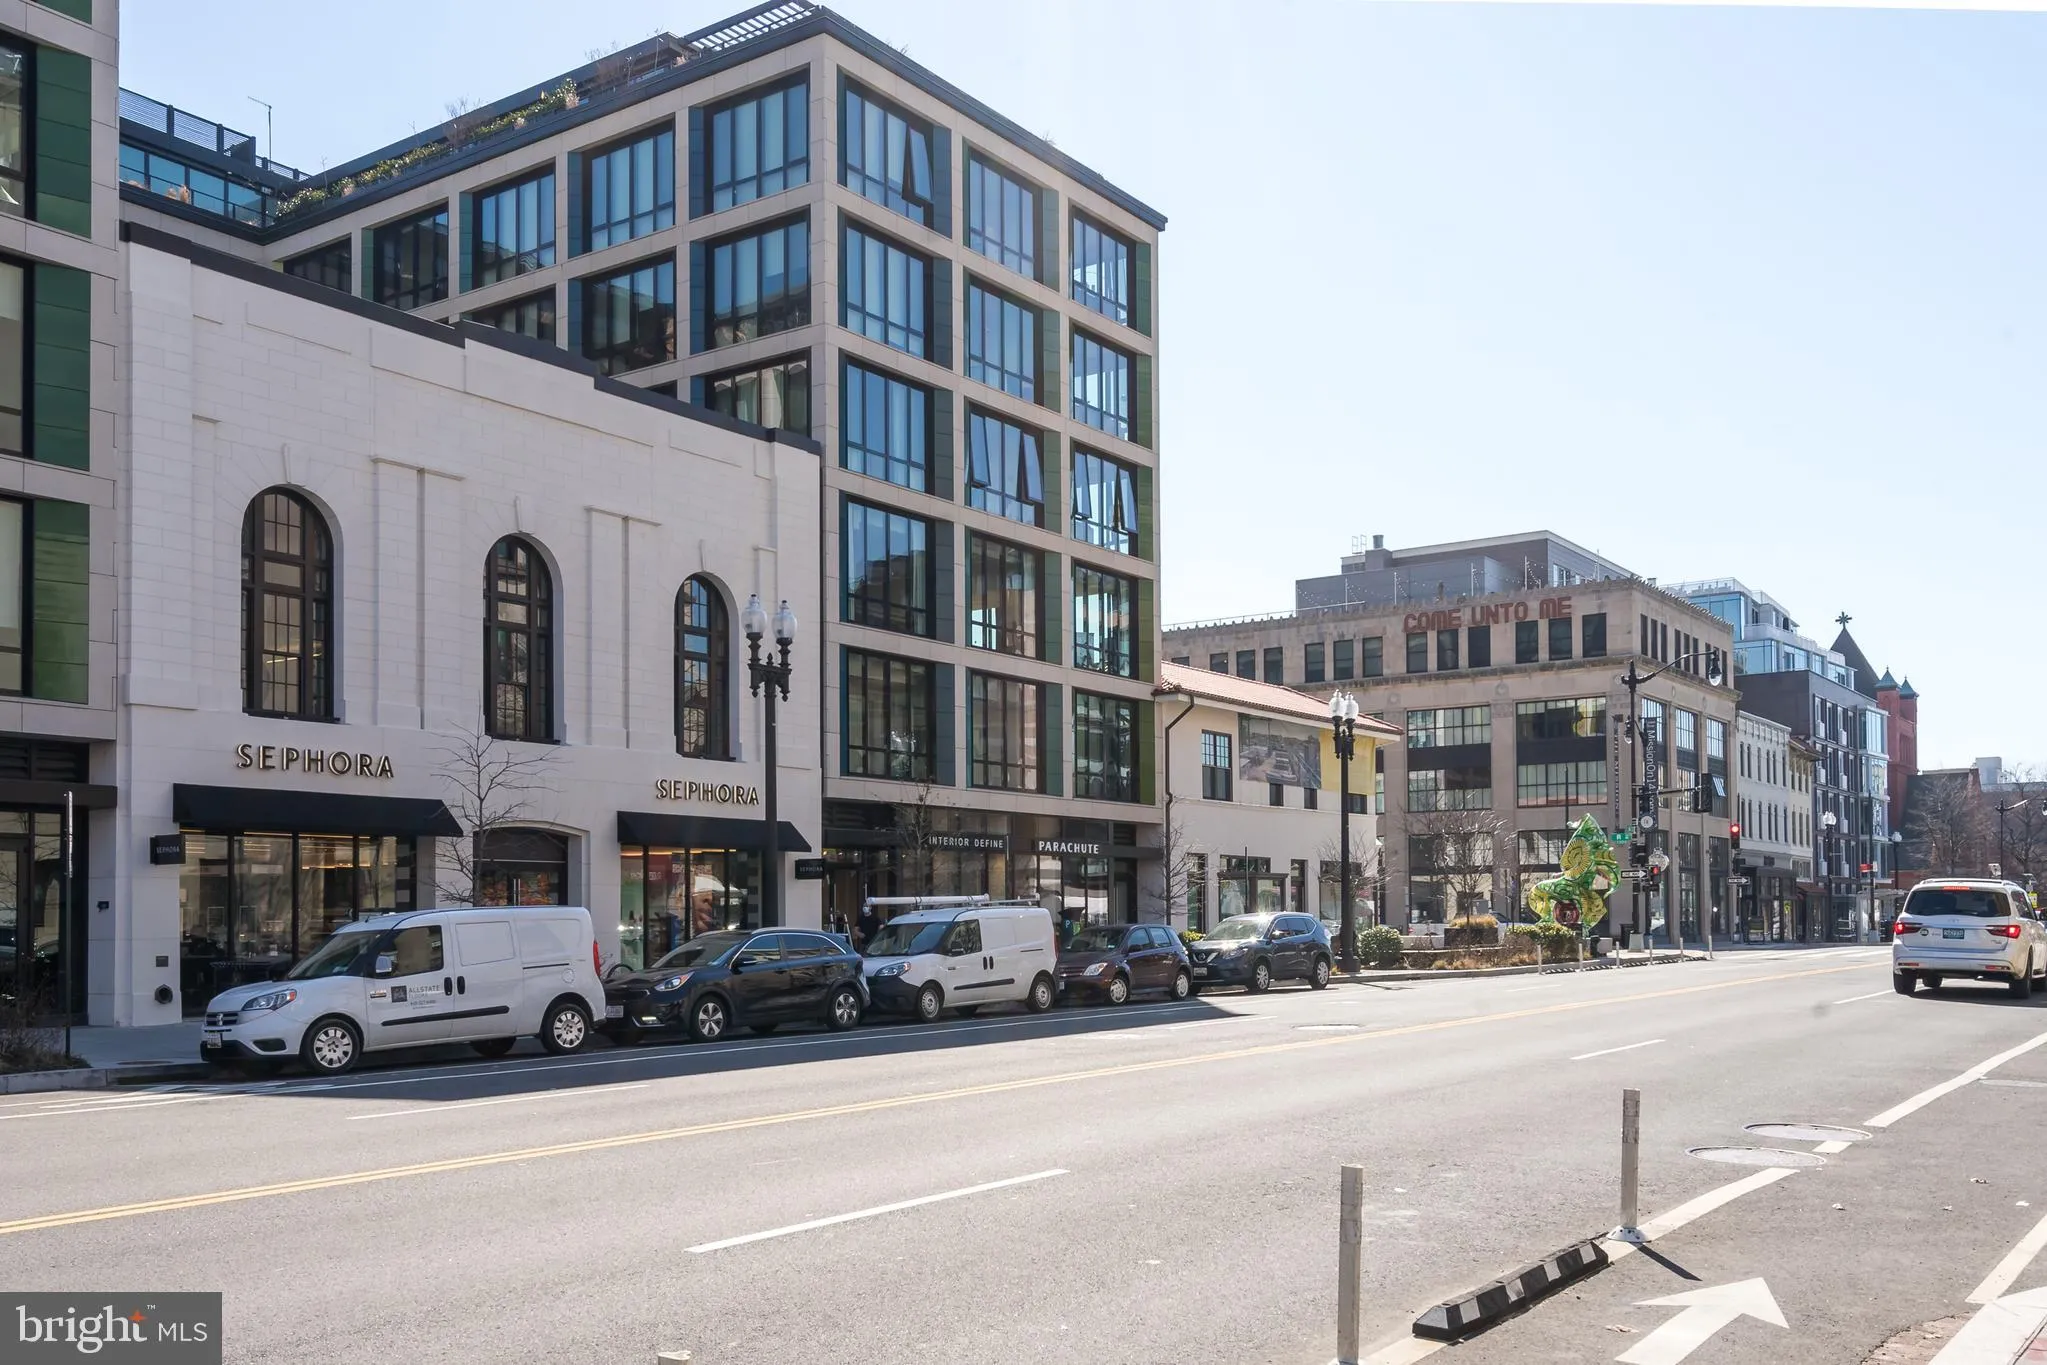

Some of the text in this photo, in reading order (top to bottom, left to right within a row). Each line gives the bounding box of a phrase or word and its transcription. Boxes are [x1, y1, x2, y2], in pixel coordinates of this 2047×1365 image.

[1403, 596, 1573, 633] COME UNTO ME
[236, 743, 394, 778] SEPHORA
[656, 779, 759, 805] SEPHORA
[928, 836, 1004, 849] INTERIOR DEFINE
[1038, 841, 1099, 854] PARACHUTE
[408, 984, 440, 993] ALLSTATE
